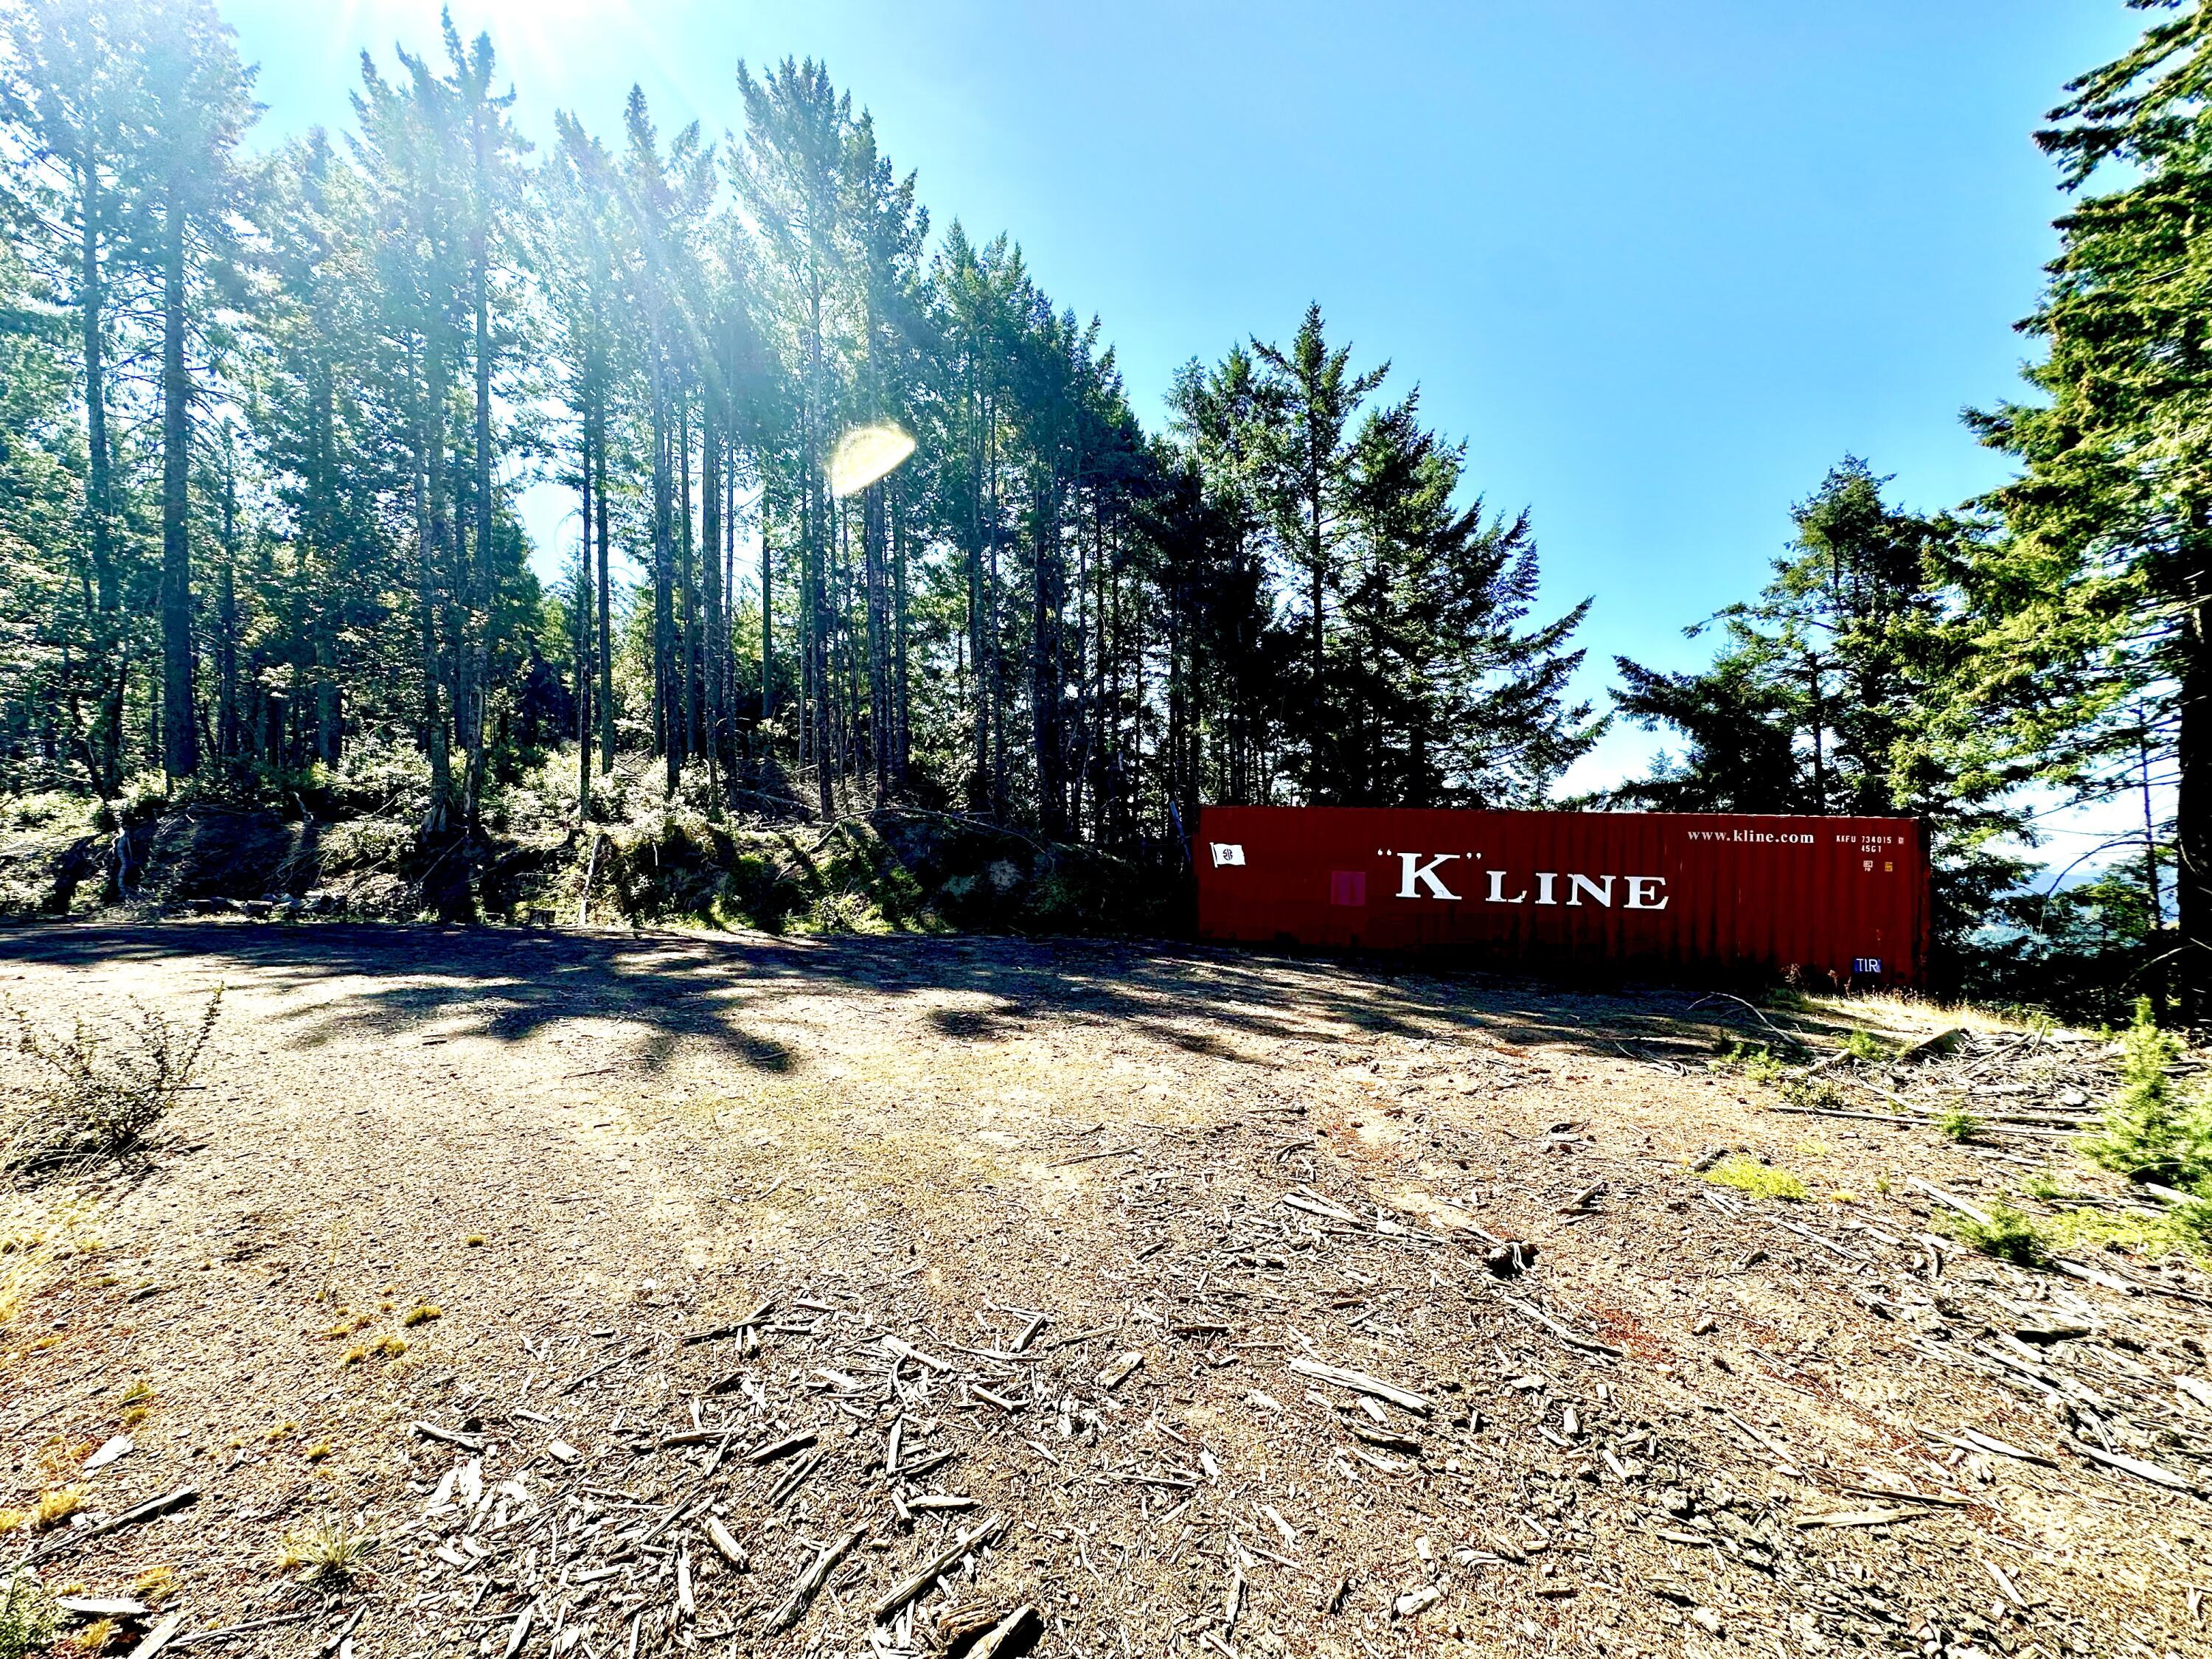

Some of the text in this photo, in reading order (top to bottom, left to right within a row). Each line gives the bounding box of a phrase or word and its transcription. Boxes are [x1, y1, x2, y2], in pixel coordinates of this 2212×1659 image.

[1688, 830, 1815, 844] www.kline.com
[1861, 835, 1892, 844] 734015
[1861, 844, 1882, 853] 45G1
[1485, 870, 1669, 910] LINE
[1855, 958, 1879, 973] TIR
